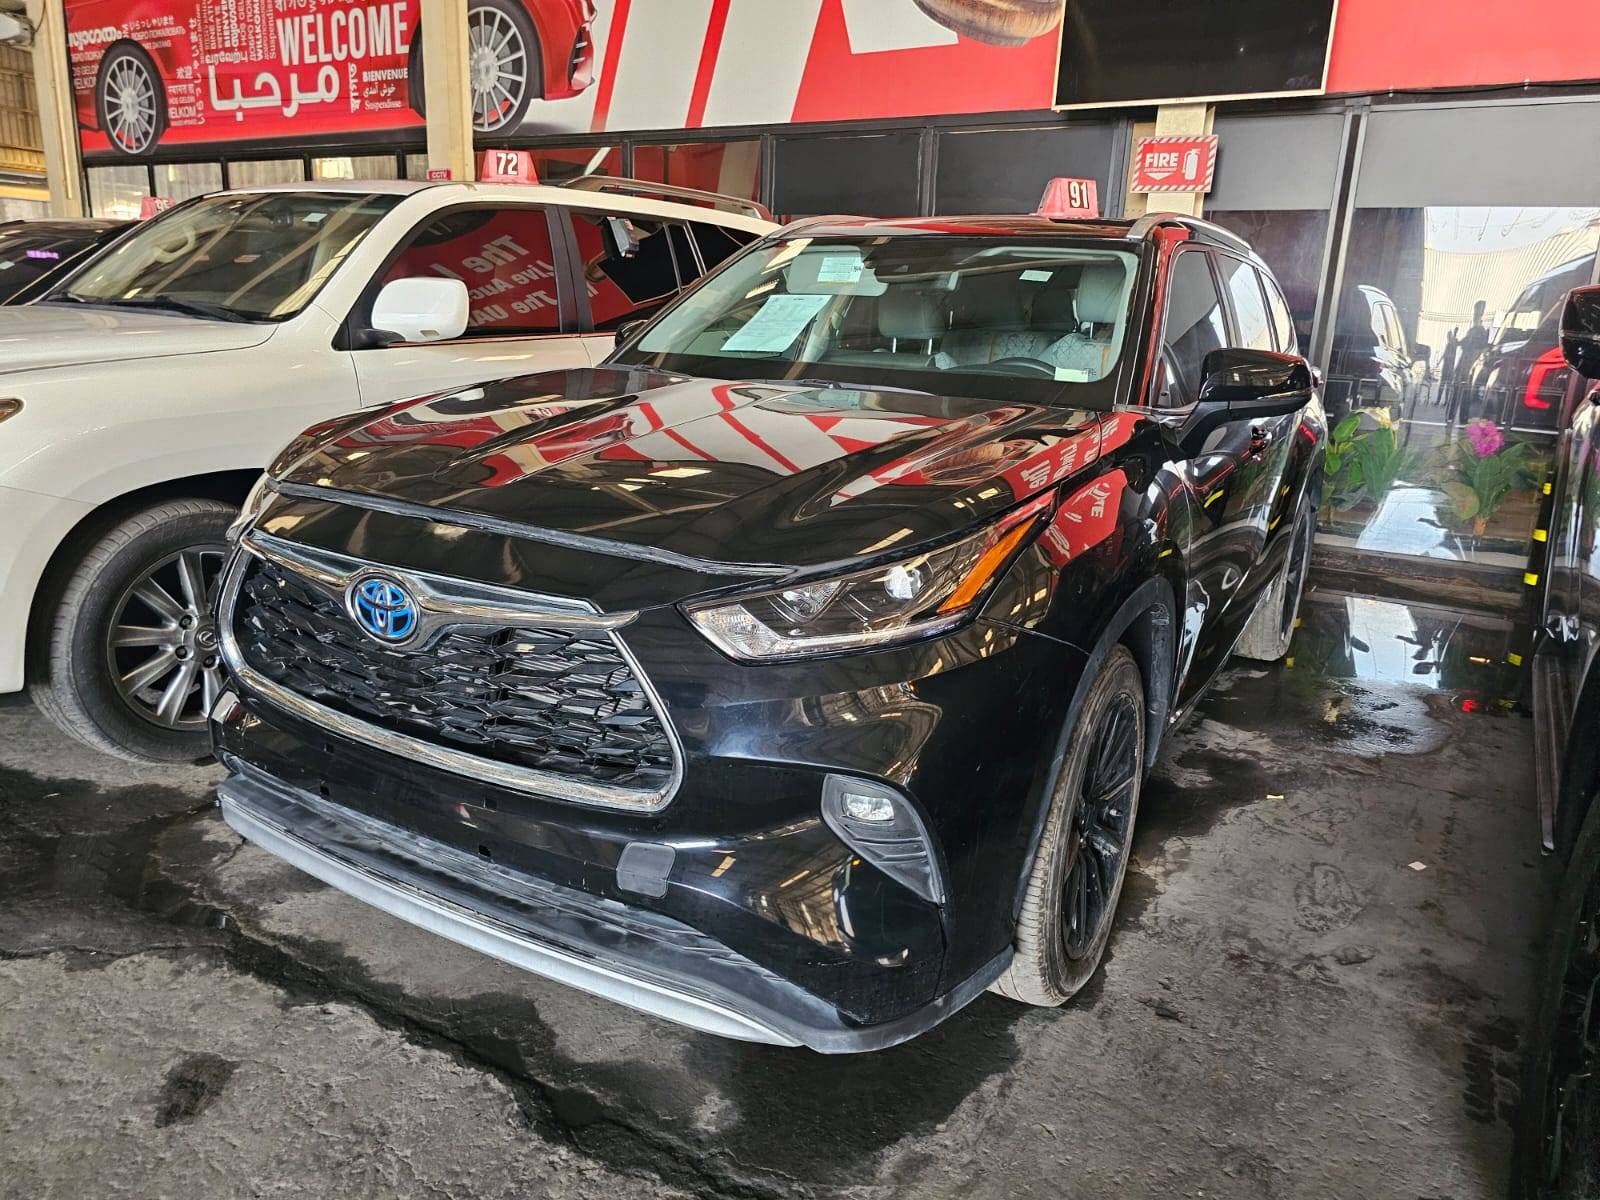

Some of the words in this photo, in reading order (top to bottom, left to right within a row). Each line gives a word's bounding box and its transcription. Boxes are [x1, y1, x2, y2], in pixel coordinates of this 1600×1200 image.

[276, 1, 410, 67] WELCOME
[362, 67, 409, 83] BIENVENUE
[207, 64, 340, 122] مرحبا
[496, 152, 518, 175] 72
[1144, 152, 1180, 168] FIRE
[432, 171, 448, 179] CCTV
[1069, 181, 1088, 208] 91
